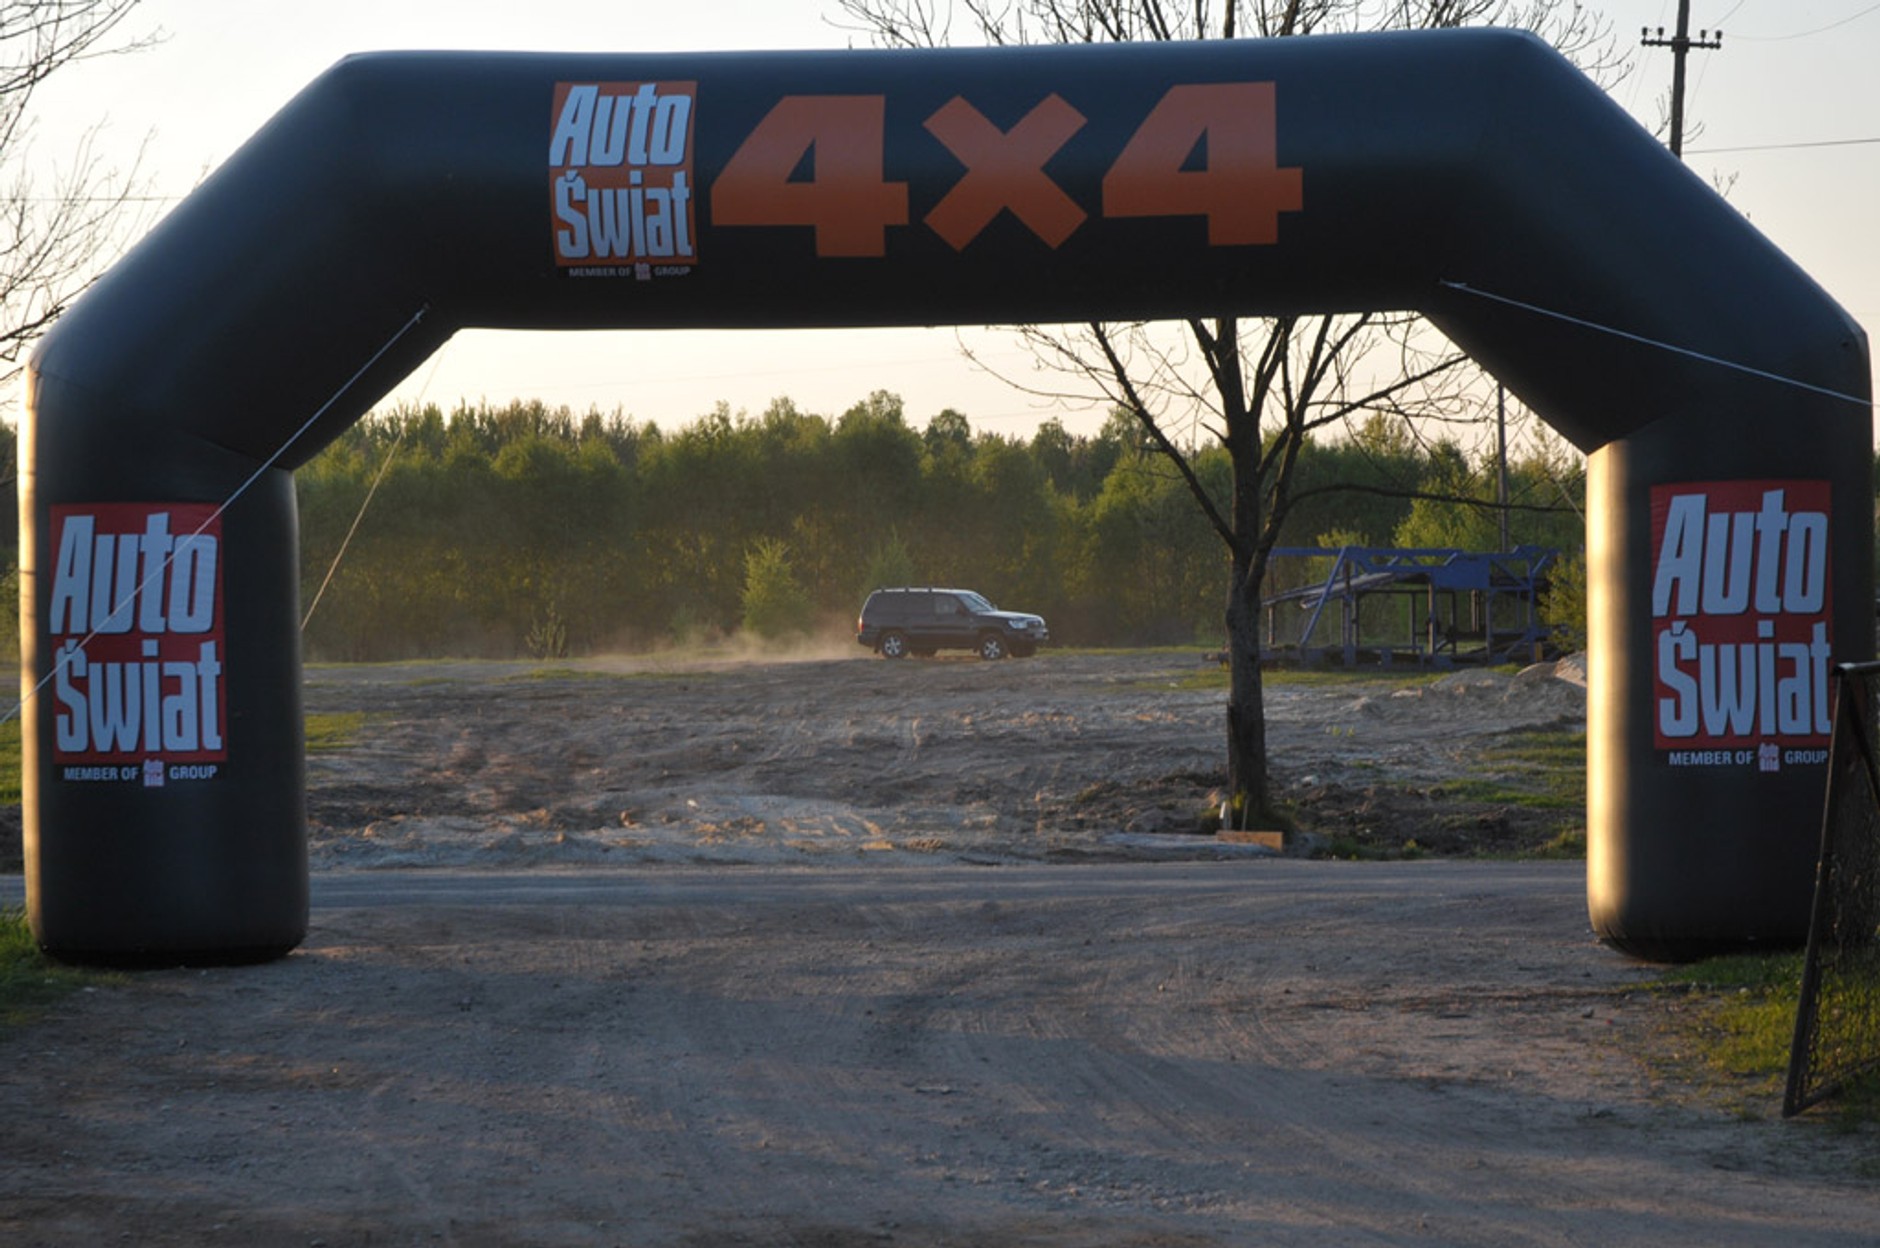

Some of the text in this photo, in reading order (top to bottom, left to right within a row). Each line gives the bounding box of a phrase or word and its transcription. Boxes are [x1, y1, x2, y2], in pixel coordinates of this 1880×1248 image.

[549, 83, 691, 166] Auto
[555, 169, 693, 258] Świat
[50, 512, 218, 634] Auto
[1652, 489, 1828, 616] Auto
[55, 639, 222, 752] Świat
[1658, 620, 1831, 737] Świat
[64, 767, 118, 781] MEMBER
[121, 767, 140, 780] OF
[169, 765, 218, 780] GROUP
[1668, 752, 1732, 766] MEMBER
[1735, 751, 1755, 765] OF
[1785, 750, 1829, 765] GROUP
